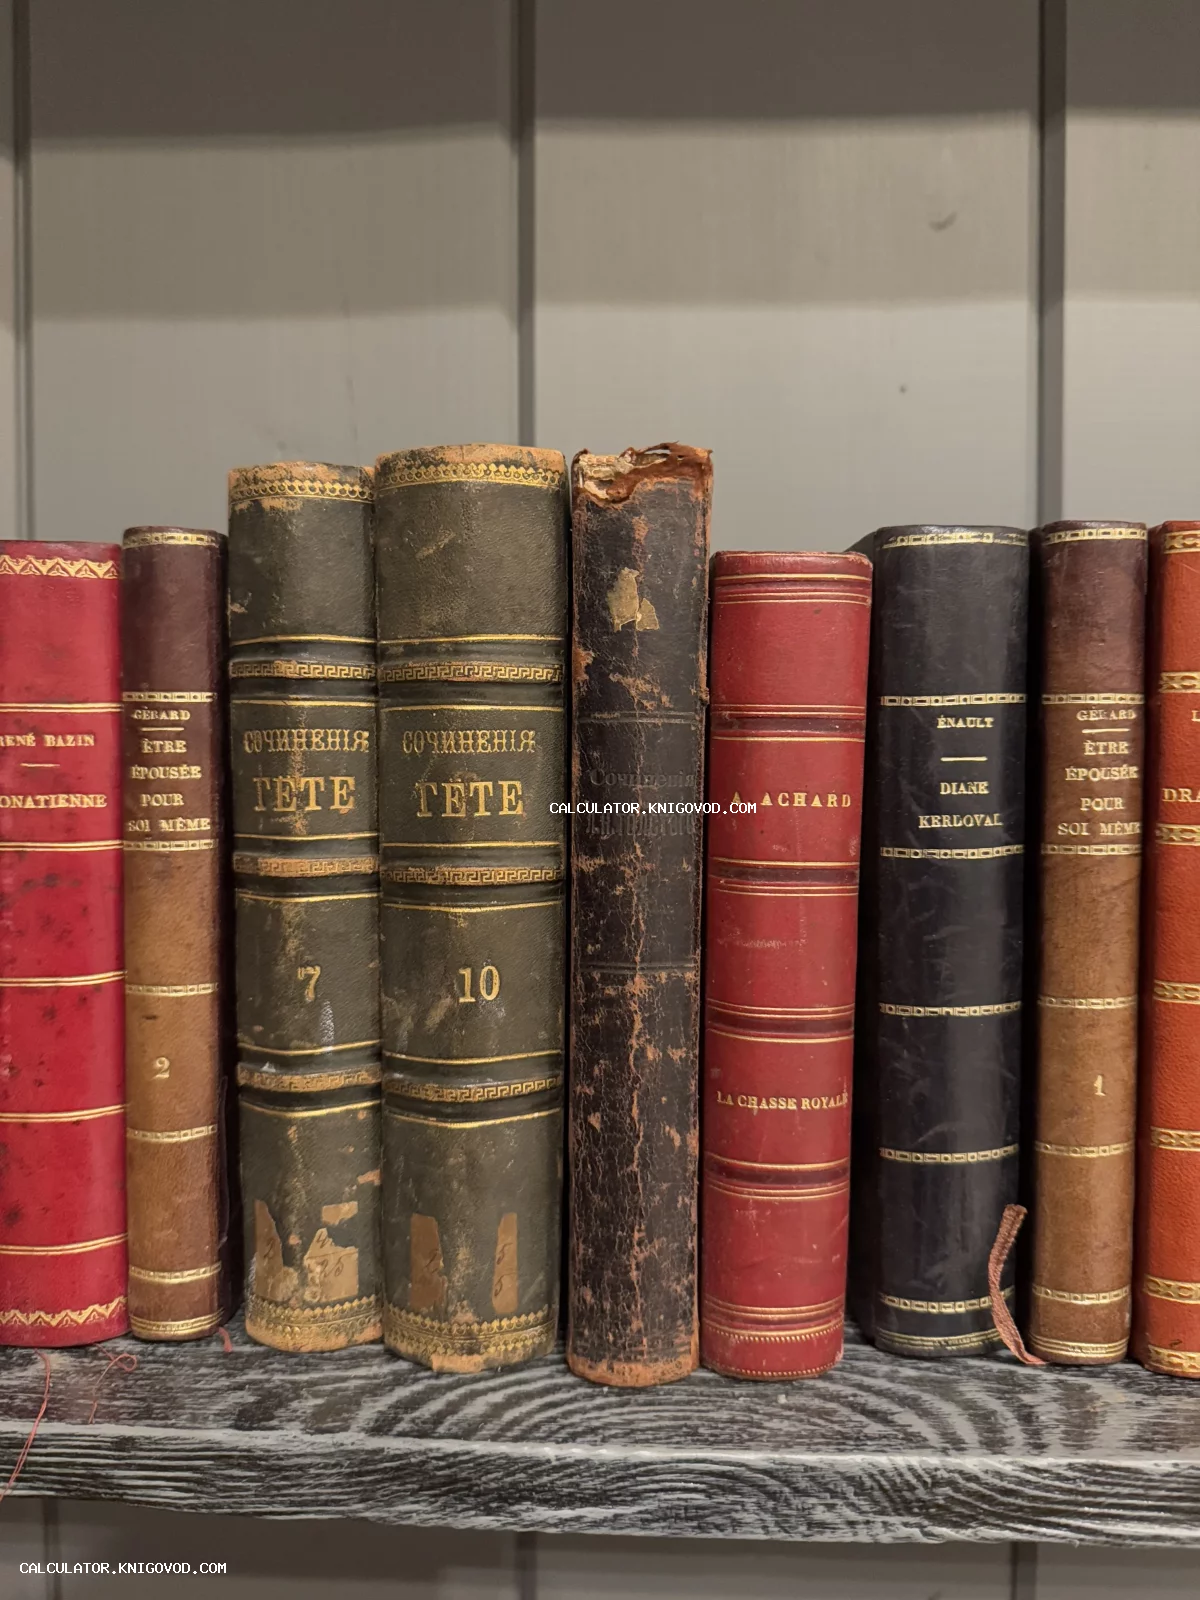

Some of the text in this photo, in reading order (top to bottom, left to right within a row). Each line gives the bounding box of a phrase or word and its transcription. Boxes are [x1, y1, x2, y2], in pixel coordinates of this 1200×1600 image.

[43, 734, 95, 746] BAZIN
[402, 729, 536, 756] СОЧИНЕНІЯ
[940, 781, 990, 795] DIANE
[140, 793, 185, 807] POUR
[760, 792, 851, 808] ACHARD
[1080, 797, 1126, 812] POUR
[1057, 822, 1090, 836] SOI
[297, 965, 321, 1000] 7
[458, 965, 500, 1003] 10
[152, 1057, 171, 1079] 2
[1093, 1074, 1106, 1097] 1
[717, 1090, 734, 1106] LA
[800, 1092, 849, 1110] ROYALE
